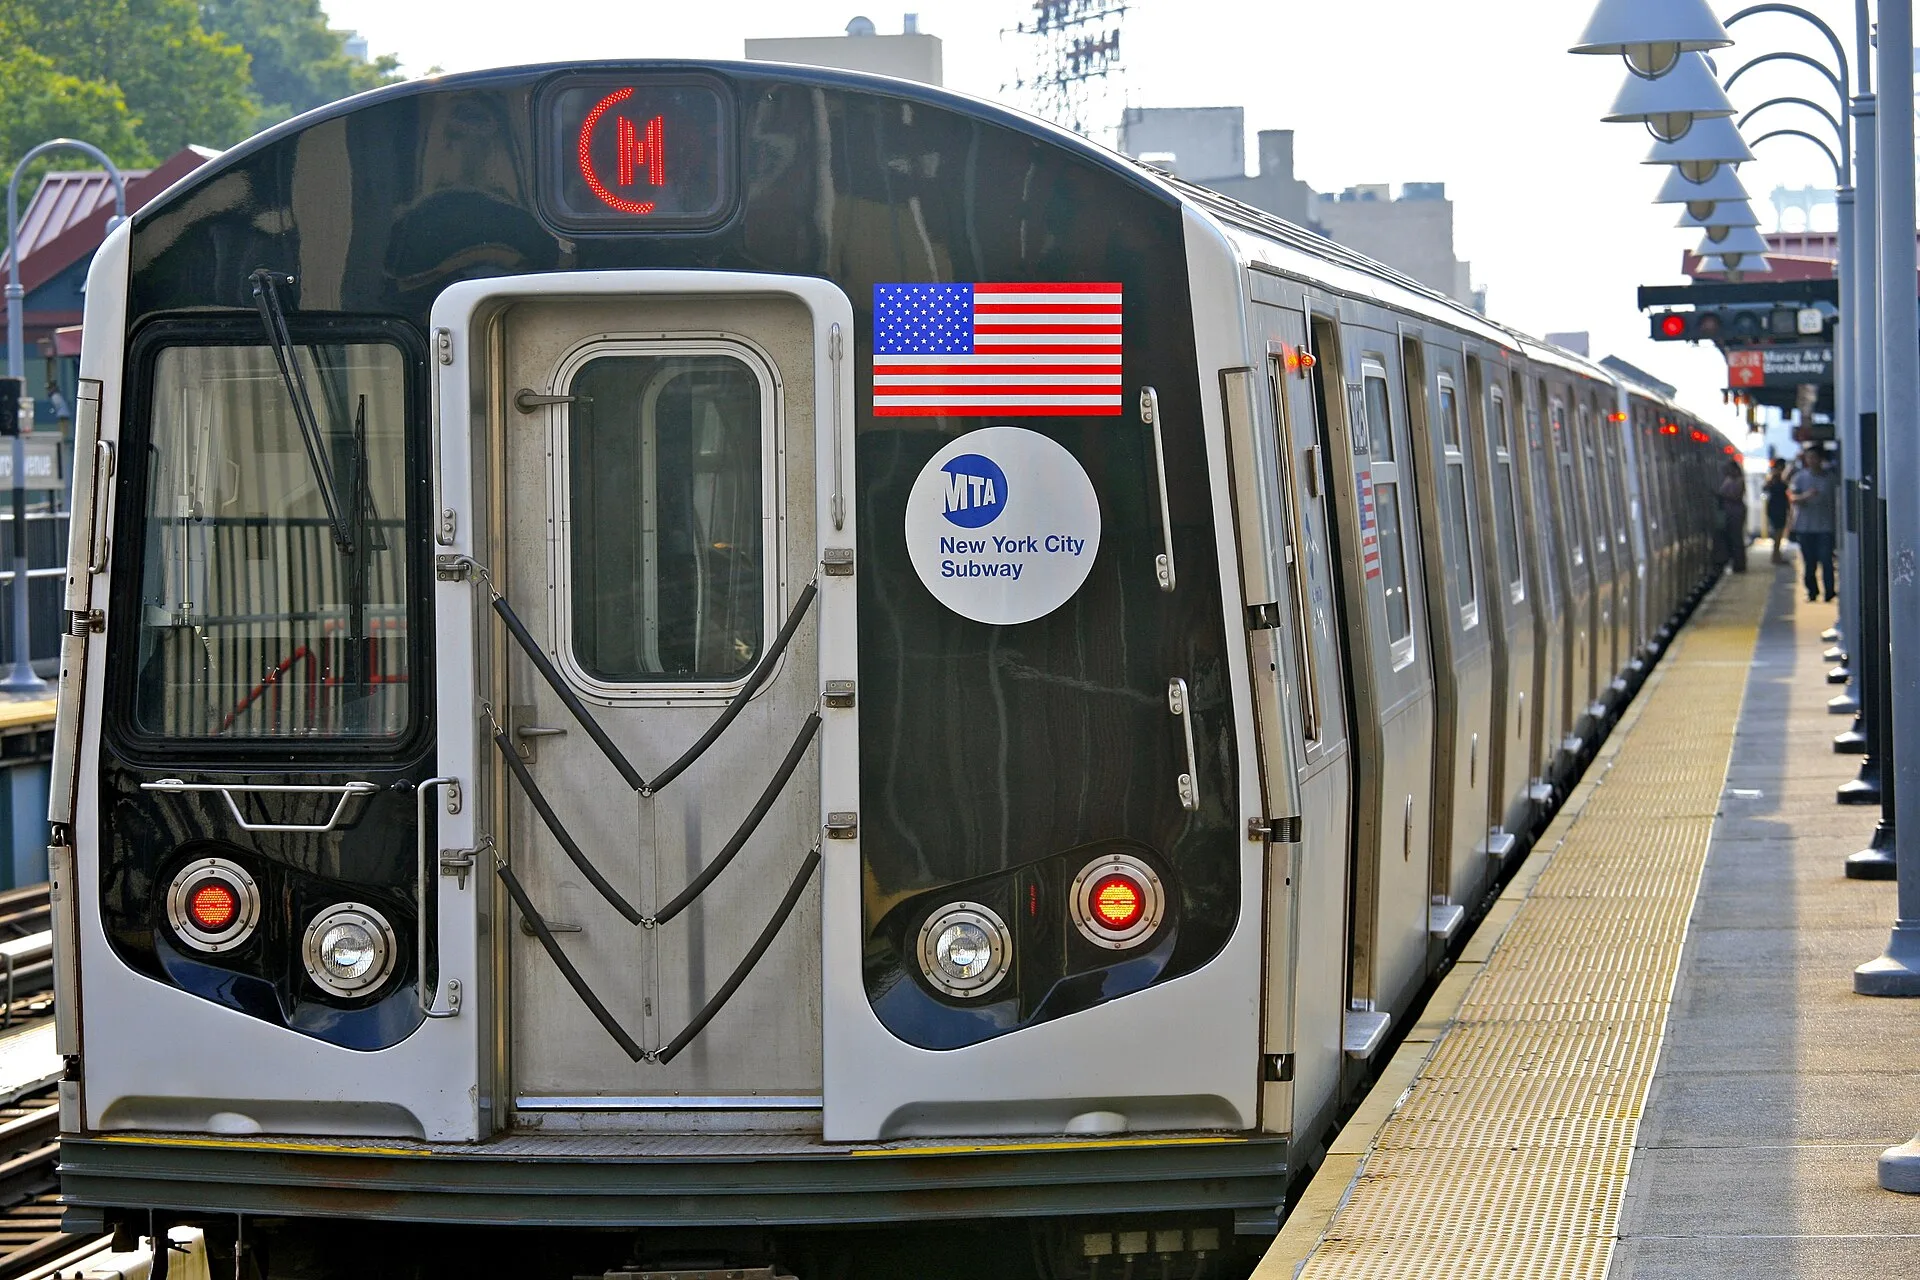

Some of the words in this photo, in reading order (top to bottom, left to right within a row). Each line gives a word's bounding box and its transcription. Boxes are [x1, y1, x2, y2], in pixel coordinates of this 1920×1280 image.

[1728, 351, 1761, 367] Exit
[1764, 350, 1801, 364] Marcy
[1803, 349, 1820, 361] Av
[1822, 348, 1832, 361] &
[1763, 362, 1824, 374] Broadway
[939, 470, 997, 514] MTA
[940, 536, 986, 554] New
[992, 535, 1038, 554] York
[1045, 535, 1085, 556] City
[941, 560, 1023, 580] Subway
